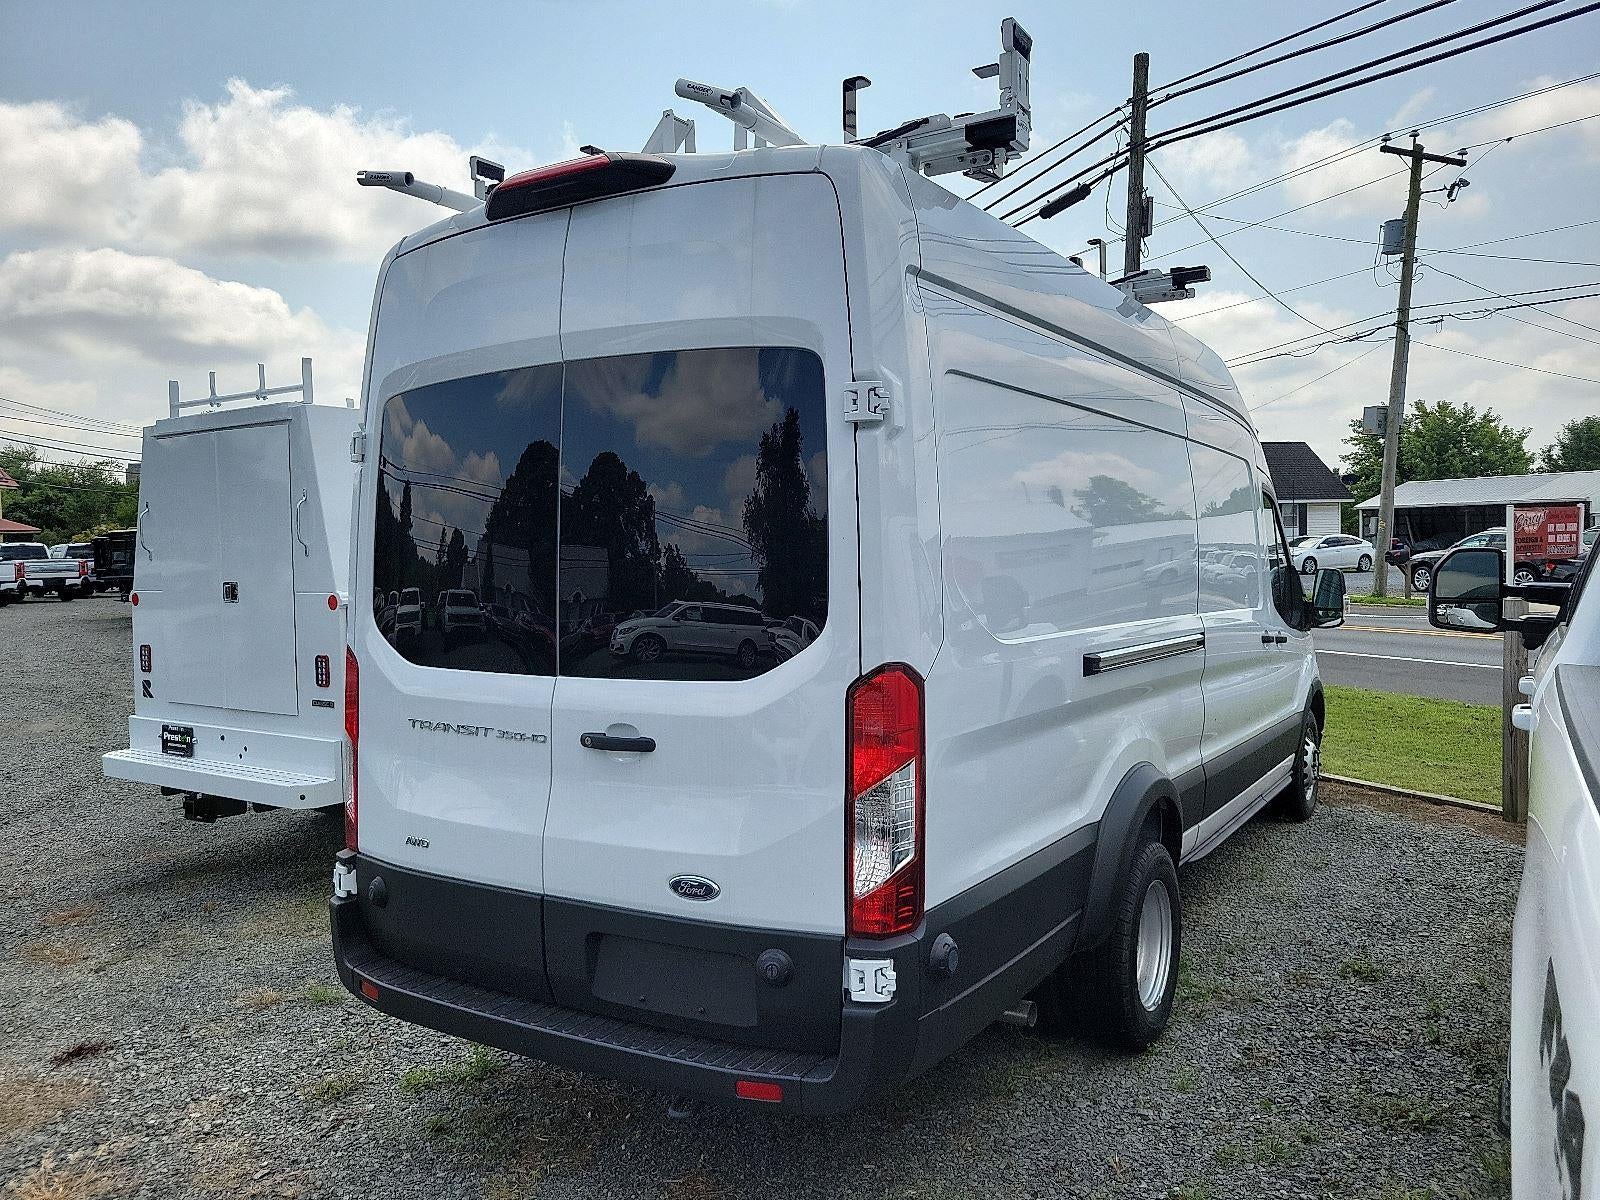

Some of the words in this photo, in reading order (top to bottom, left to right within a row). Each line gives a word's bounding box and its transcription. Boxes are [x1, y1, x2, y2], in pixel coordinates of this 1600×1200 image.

[407, 718, 495, 737] TRANSIT
[405, 835, 430, 848] AWD
[678, 880, 706, 896] Ford
